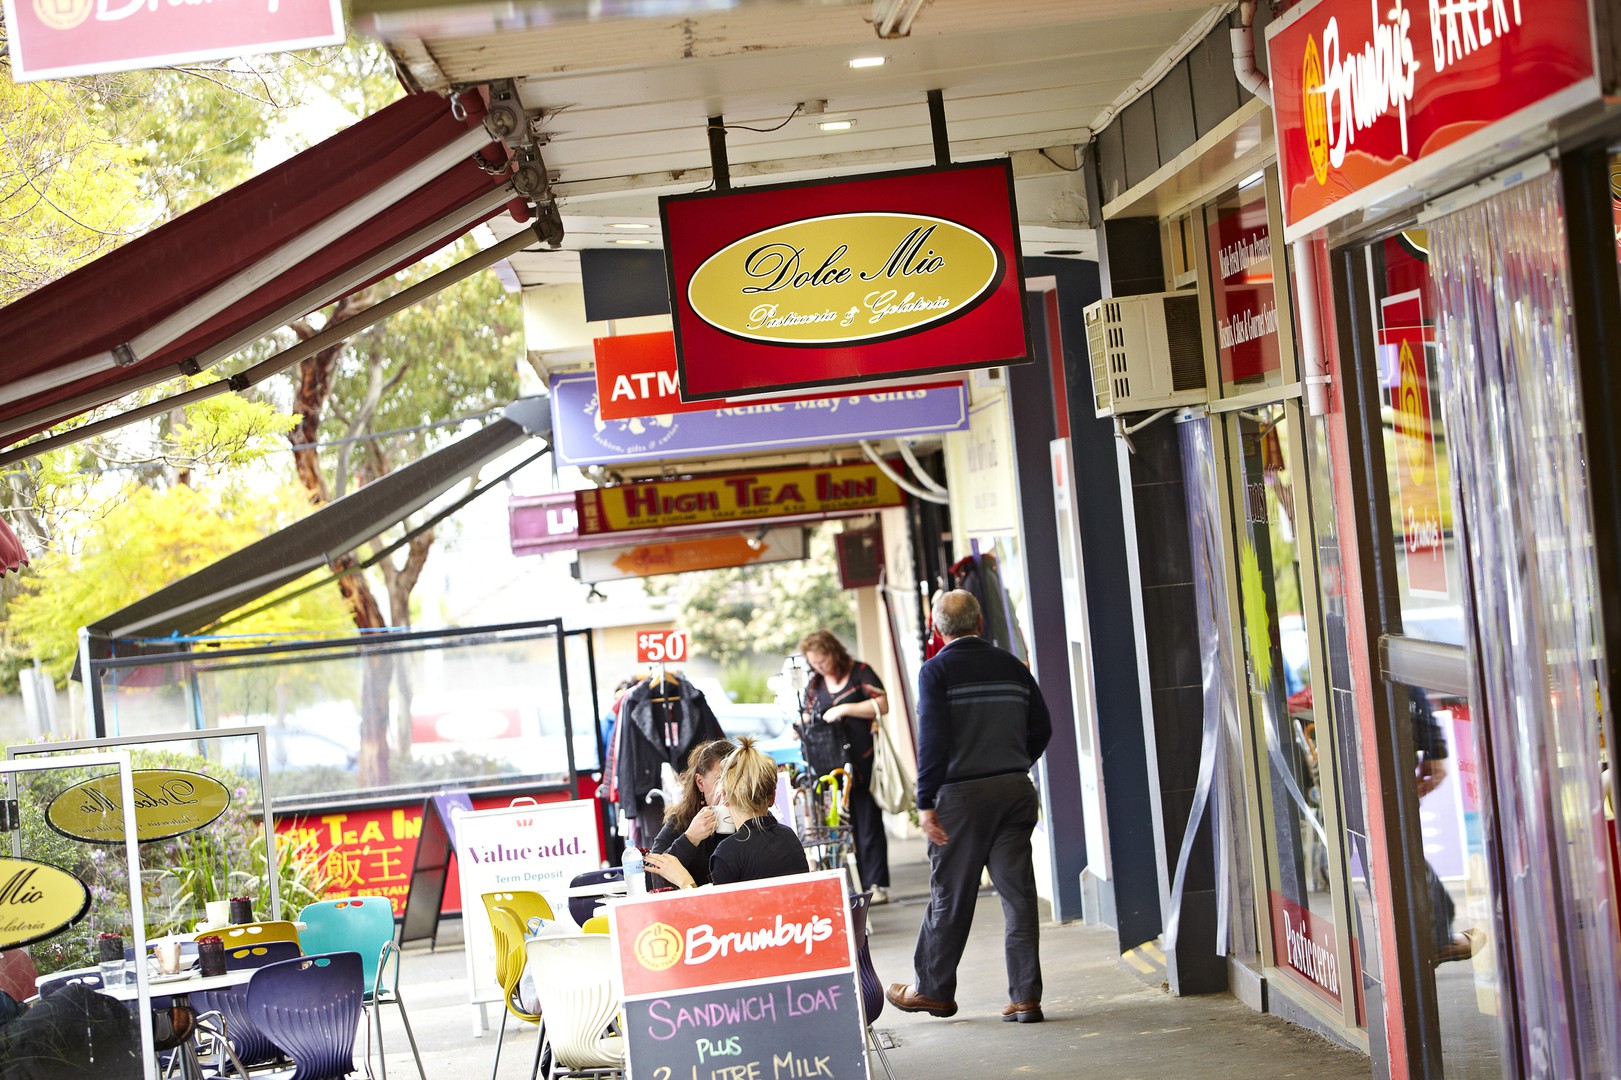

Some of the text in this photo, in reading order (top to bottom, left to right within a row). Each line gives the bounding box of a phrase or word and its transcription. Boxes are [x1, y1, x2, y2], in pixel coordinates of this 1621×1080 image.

[1323, 0, 1522, 168] Brumby's BAKE
[741, 224, 946, 294] Dolce Mio
[746, 289, 950, 331] Pasticceria & Gelateria
[611, 370, 679, 402] ATM
[624, 486, 719, 518] HIGH
[725, 477, 805, 508] TEA
[815, 472, 877, 501] INN
[639, 632, 684, 661] $50
[321, 814, 385, 846] TEA
[392, 809, 423, 840] IN
[469, 837, 587, 864] Value add.
[496, 870, 563, 884] Term Deposit
[0, 912, 45, 932] elateria
[684, 914, 833, 965] Brumby's
[1283, 909, 1338, 996] Pasticceria
[648, 984, 842, 1041] SANDWICH LOAF
[696, 1036, 742, 1064] PLUS
[773, 1051, 834, 1080] MILK
